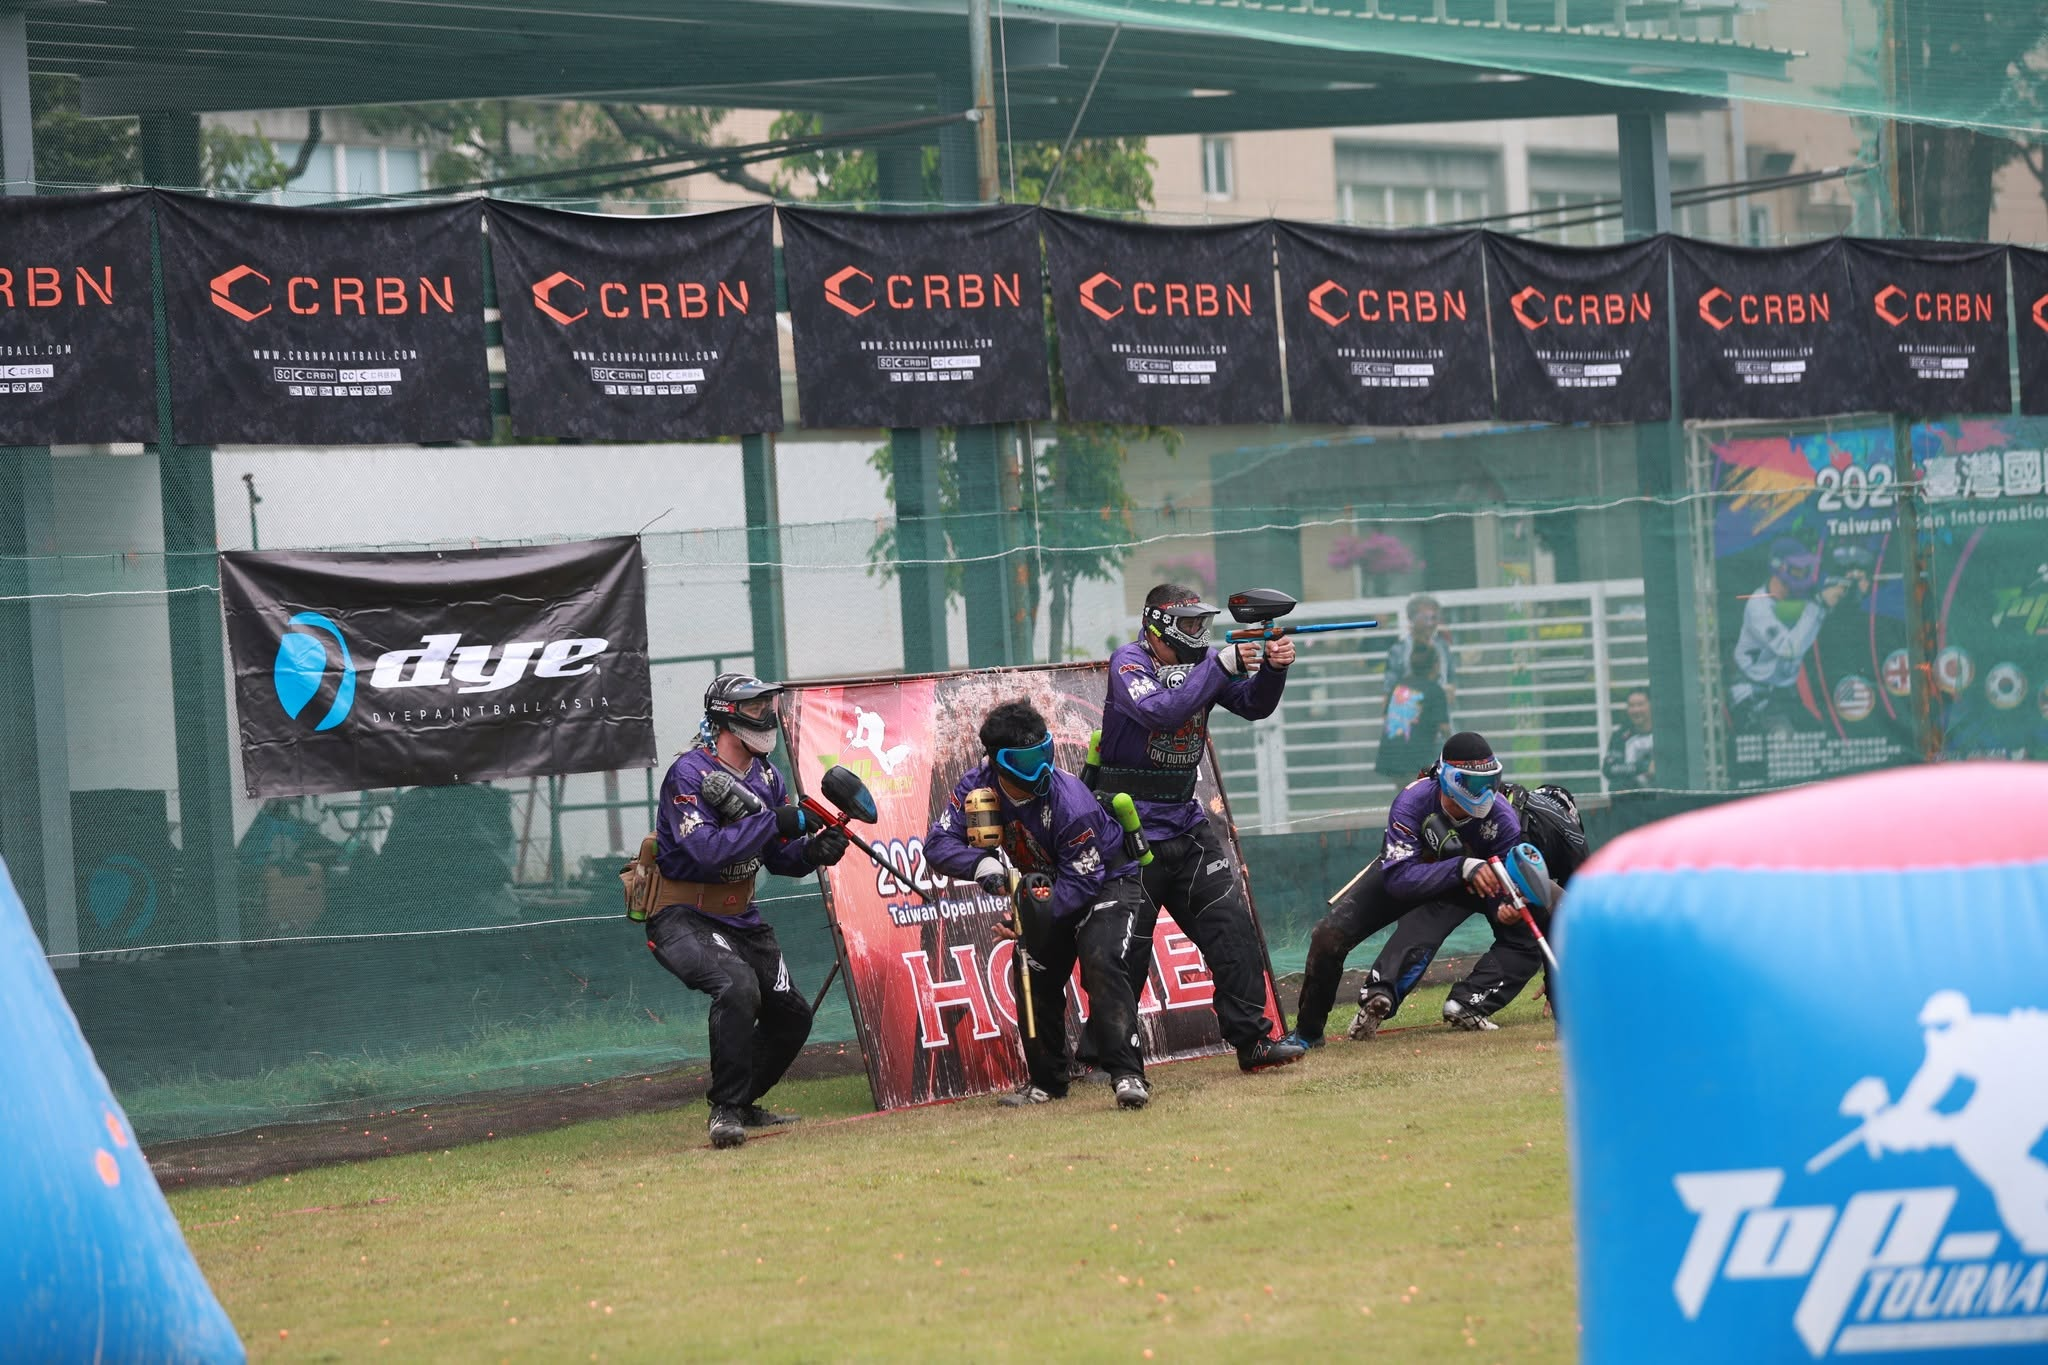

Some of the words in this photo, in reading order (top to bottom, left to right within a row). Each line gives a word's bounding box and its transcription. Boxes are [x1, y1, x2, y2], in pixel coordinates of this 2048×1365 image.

[287, 276, 454, 315] CRBN
[600, 281, 749, 319] CRBN
[887, 273, 1021, 310] CRBN
[1133, 282, 1252, 317] CRBN
[1358, 290, 1467, 322] CRBN
[1740, 292, 1830, 325] CRBN
[1915, 292, 1992, 322] CRBN
[1554, 292, 1651, 326] CRBN
[252, 350, 417, 361] WWW.CRBNPAINTBALL.COM
[572, 350, 719, 362] WWW.CRBNPAINTBALL.COM
[306, 371, 334, 380] CRBN
[1816, 463, 1899, 512] 202
[1922, 451, 2048, 501] 臺灣國
[1827, 517, 1892, 537] Taiwan
[1951, 503, 2048, 527] Internatio
[370, 633, 609, 694] dye
[888, 903, 939, 926] Taiwan
[940, 898, 976, 922] Open
[902, 915, 1215, 1050] HE
[1854, 1261, 2048, 1322] TOURNA
